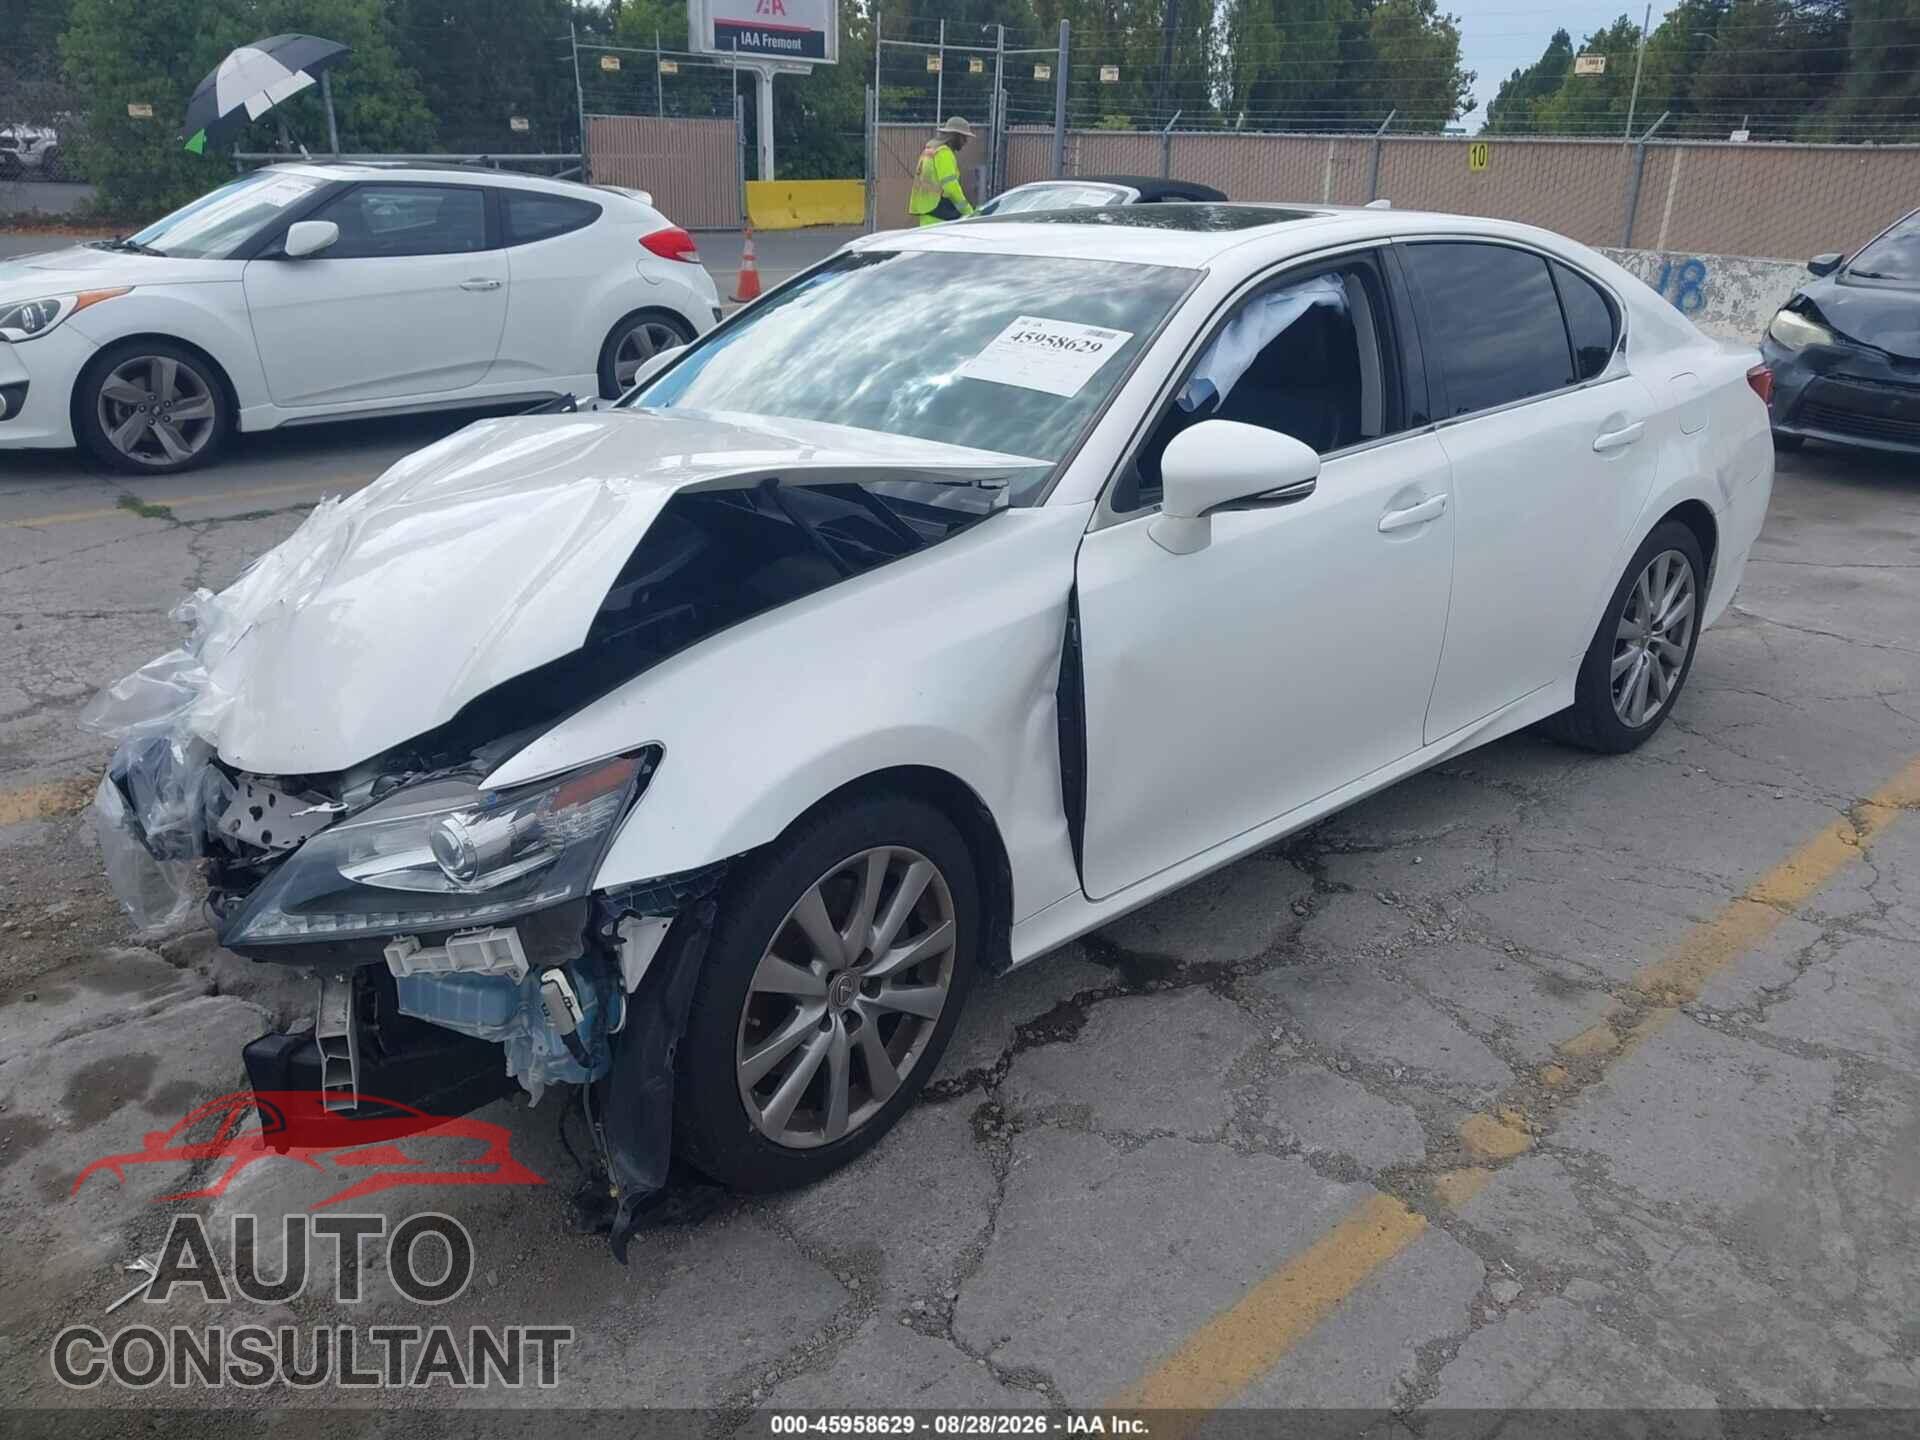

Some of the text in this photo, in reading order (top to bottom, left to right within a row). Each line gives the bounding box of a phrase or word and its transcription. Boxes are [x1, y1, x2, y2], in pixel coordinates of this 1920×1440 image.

[740, 31, 801, 49] IAA Fremont
[1472, 144, 1486, 168] 10
[1657, 259, 1707, 310] 18
[1010, 331, 1103, 353] 45958629
